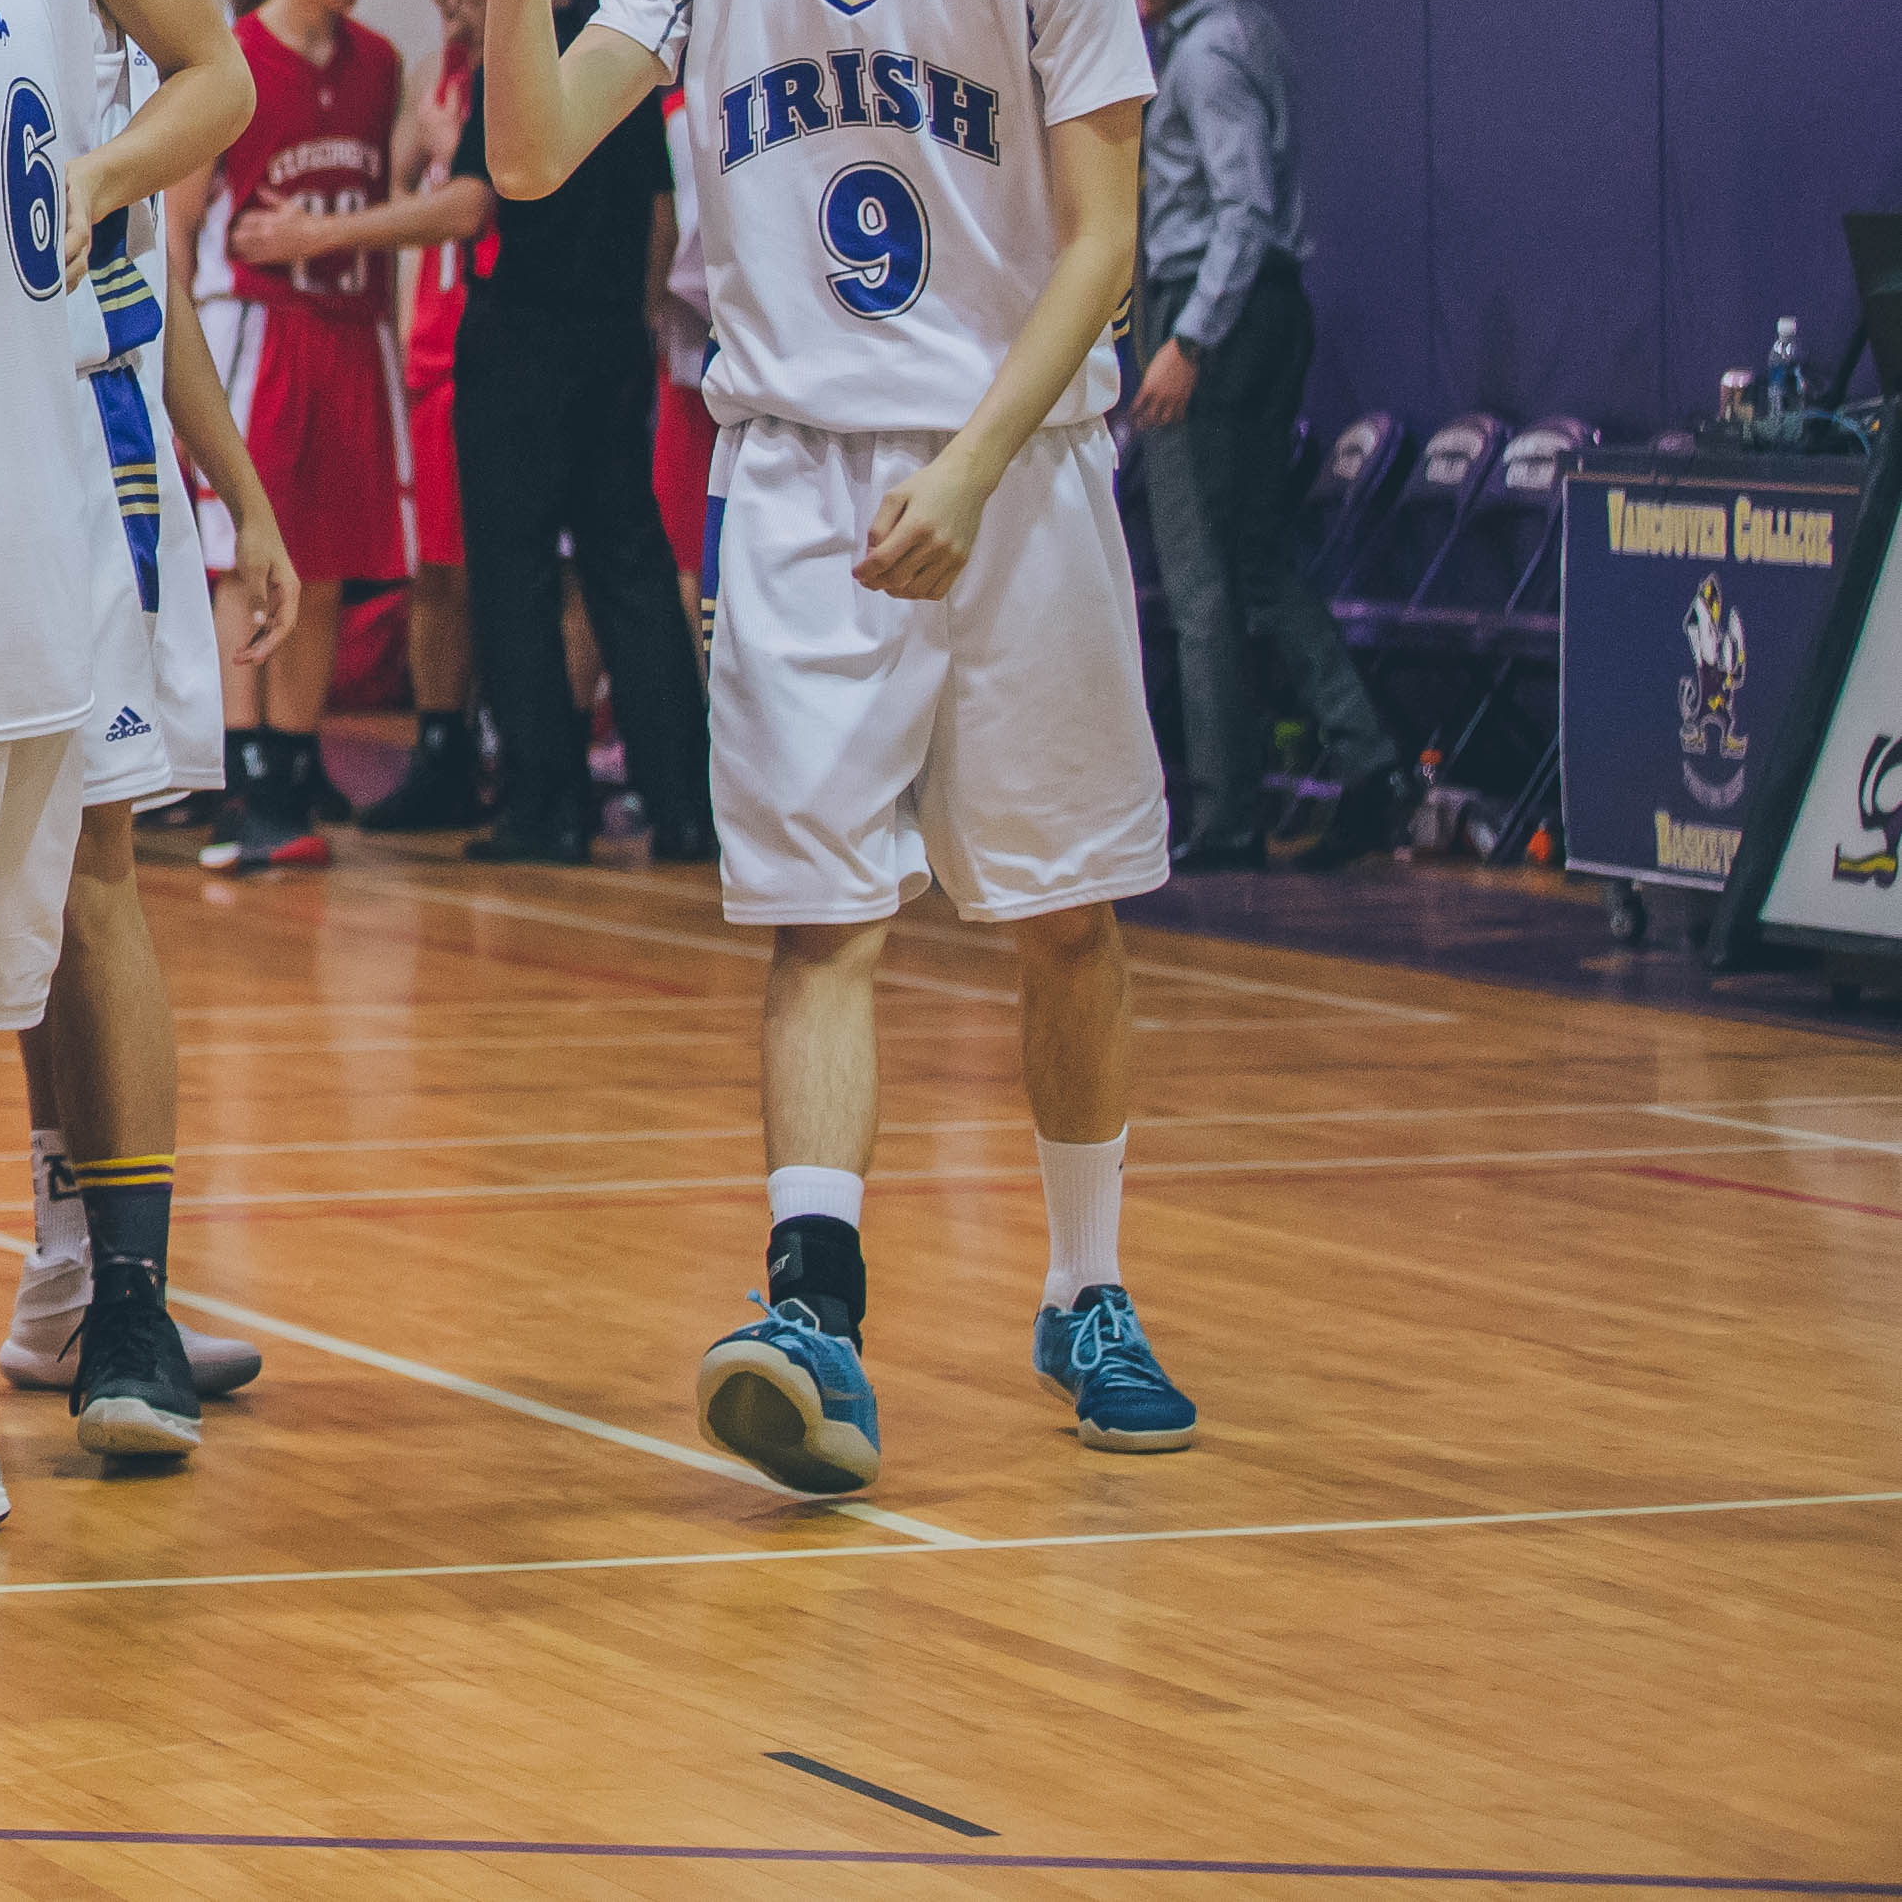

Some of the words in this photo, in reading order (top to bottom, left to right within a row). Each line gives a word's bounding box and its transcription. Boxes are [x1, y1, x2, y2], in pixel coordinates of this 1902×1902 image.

[719, 48, 1000, 175] IRISH
[0, 77, 63, 301] 6
[818, 161, 931, 320] 9
[105, 723, 152, 742] adidas
